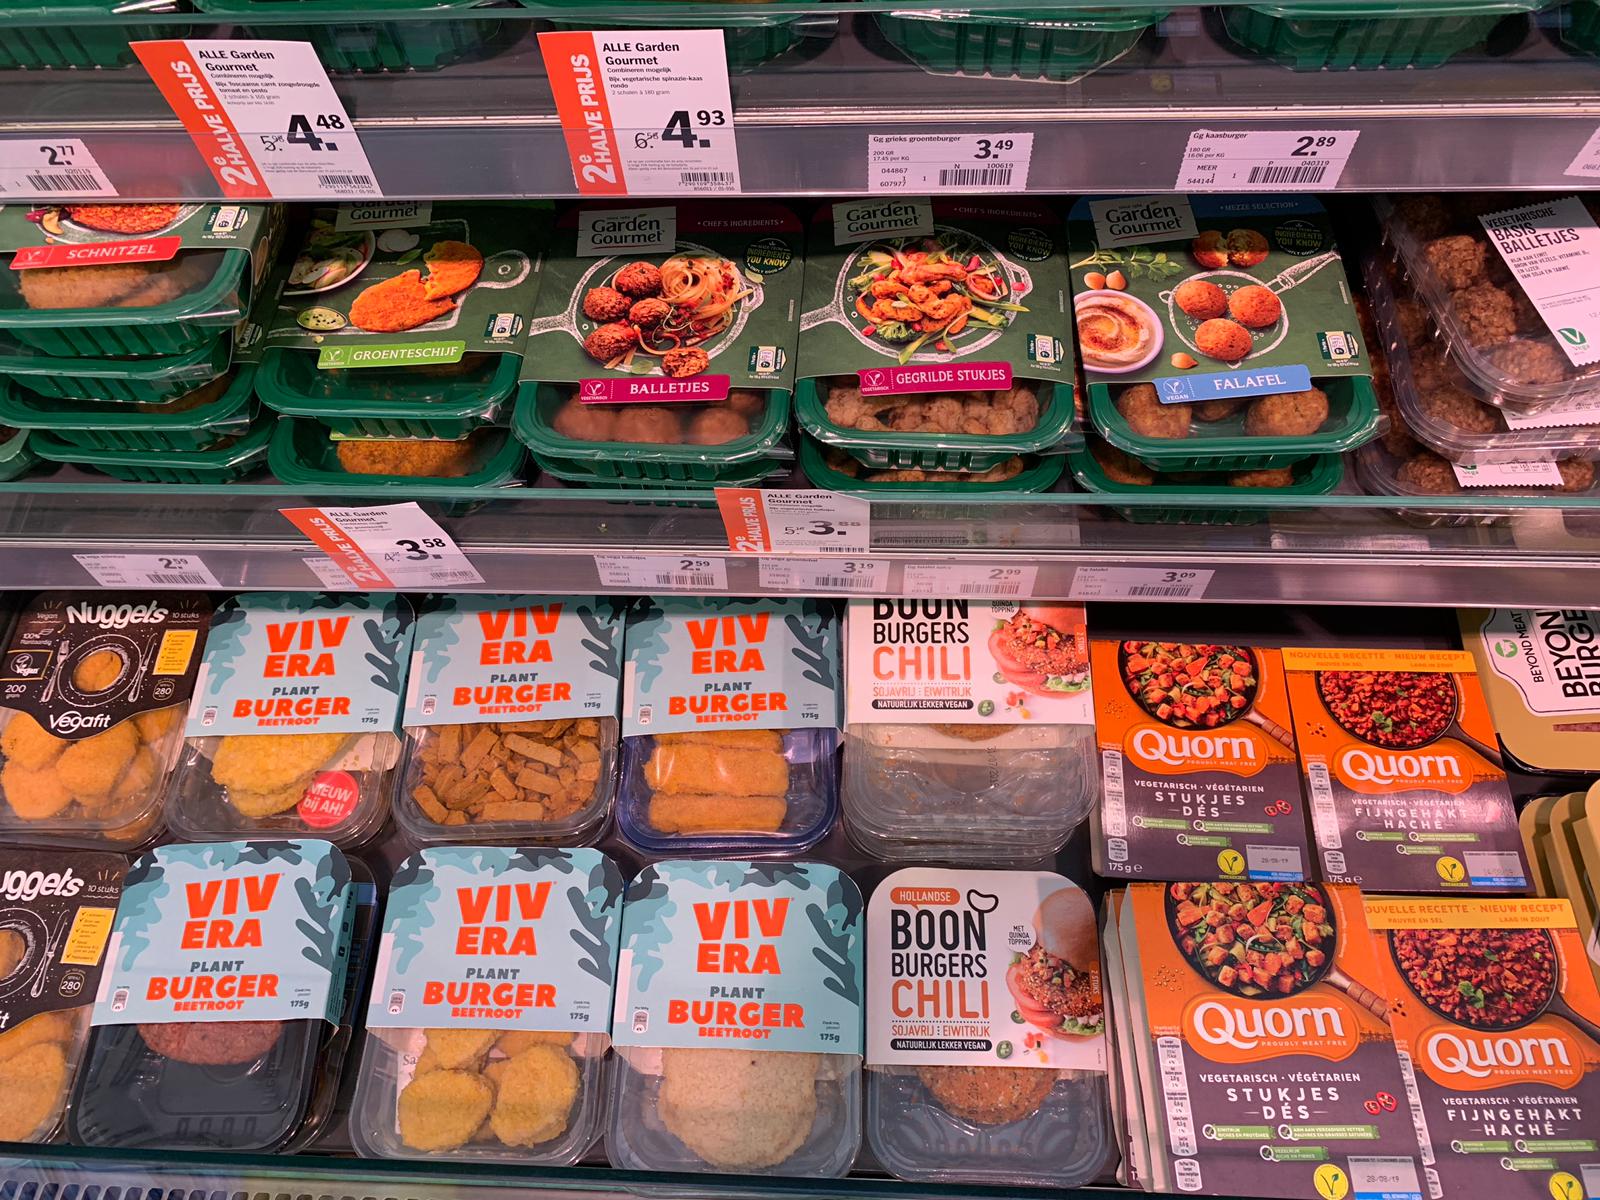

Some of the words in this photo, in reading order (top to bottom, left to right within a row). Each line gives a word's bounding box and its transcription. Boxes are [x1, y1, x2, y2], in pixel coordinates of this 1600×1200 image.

[199, 51, 228, 59] ALLE
[231, 51, 274, 60] Garden
[603, 43, 631, 52] ALLE
[635, 43, 679, 51] Garden
[206, 63, 258, 72] Gourmet
[606, 56, 658, 66] Gourmet
[171, 61, 214, 110] PRIJS
[571, 54, 598, 106] PRIJS
[287, 115, 345, 151] 4.48
[584, 111, 612, 163] HALVE
[661, 110, 725, 148] 4.93
[202, 114, 246, 166] HALVE
[974, 139, 1013, 159] 3.49
[1291, 136, 1336, 156] 2.89
[40, 146, 75, 165] 2.77
[351, 207, 418, 220] Gourmet
[846, 204, 916, 222] Garden
[1105, 203, 1176, 223] Garden
[1225, 202, 1253, 211] MEZZE
[1255, 202, 1294, 210] SELECTION
[591, 219, 661, 233] Garden
[847, 215, 921, 233] Gourmet
[1109, 218, 1182, 236] Gourmet
[1486, 207, 1556, 229] VEGETARISCHE
[591, 232, 664, 245] Gourmet
[1492, 223, 1536, 241] BASIS
[1501, 228, 1580, 254] BALLETJES
[66, 244, 156, 260] SCHNITZEL
[764, 258, 788, 267] KNOW
[354, 347, 458, 361] GROENTESCHIJF
[897, 371, 953, 385] GEGRILDE
[958, 370, 1006, 381] STUKJES
[1213, 374, 1286, 390] FALAFEL
[630, 382, 710, 394] BALLETJES
[740, 497, 756, 517] PRIJS
[310, 517, 344, 542] PRIJS
[745, 519, 763, 541] HALVE
[337, 544, 371, 572] HALVE
[396, 538, 446, 561] 3.58
[158, 558, 188, 569] 2.59
[843, 562, 874, 573] 3.19
[989, 569, 1021, 579] 2.99
[1162, 572, 1196, 582] 3.09
[66, 600, 168, 629] Nuggets
[478, 603, 564, 641] VIV
[266, 616, 350, 652] VIV
[685, 612, 770, 649] VIV
[874, 622, 969, 644] BURGERS
[1511, 612, 1529, 639] MEAT
[480, 640, 553, 665] ERA
[692, 649, 765, 674] ERA
[1522, 638, 1544, 683] BEYOND
[263, 653, 335, 678] ERA
[873, 646, 970, 680] CHILI
[5, 685, 26, 693] 200
[155, 687, 172, 695] 280
[272, 686, 320, 695] PLANT
[453, 683, 571, 706] BURGER
[233, 697, 350, 717] BURGER
[669, 692, 788, 715] BURGER
[50, 711, 111, 733] Vegafit
[1133, 729, 1255, 766] Quorn
[1342, 750, 1461, 785] Quorn
[310, 782, 353, 800] NIEUW
[1134, 780, 1197, 790] VEGETARISCH
[1206, 784, 1264, 792] VÉGÉTARIEN
[304, 797, 320, 812] bij
[320, 802, 344, 816] AH!
[1155, 792, 1245, 805] STUKJES
[1183, 803, 1220, 817] DÉS
[1355, 808, 1468, 818] FIJNGEHAKT
[1384, 818, 1443, 829] HACHÉ
[186, 873, 280, 919] VIV
[456, 881, 552, 924] VIV
[900, 892, 951, 902] HOLLANDSE
[1419, 904, 1468, 914] RECETTE
[1480, 904, 1512, 914] NIEUW
[1514, 904, 1564, 913] RECEPT
[693, 897, 790, 941] VIV
[181, 919, 262, 949] ERA
[891, 909, 986, 951] BOON
[456, 927, 537, 956] ERA
[1008, 938, 1031, 946] TOPPING
[190, 961, 244, 972] PLANT
[697, 943, 781, 974] ERA
[892, 953, 987, 978] BURGERS
[466, 968, 520, 980] PLANT
[61, 981, 80, 990] 280
[146, 974, 279, 1000] BURGER
[710, 986, 765, 999] PLANT
[423, 982, 556, 1008] BURGER
[892, 979, 989, 1019] CHILI
[174, 1000, 244, 1011] BEETROOT
[451, 1008, 522, 1019] BEETROOT
[668, 1000, 805, 1028] BURGER
[699, 1027, 771, 1039] BEETROOT
[892, 1025, 934, 1036] SOJAVRIJ
[943, 1025, 990, 1037] EIWITRIJK
[1194, 1002, 1344, 1050] Quorn
[820, 1033, 840, 1043] 175g
[897, 1041, 937, 1049] NATUURLIJK
[938, 1041, 962, 1049] LEKKER
[964, 1041, 986, 1049] VEGAN
[1427, 1032, 1570, 1078] Quorn
[1200, 1073, 1278, 1083] VEGETARISCH
[1288, 1072, 1361, 1082] VÉGÉTARIEN
[1227, 1087, 1340, 1102] STUKJES
[1443, 1097, 1510, 1105] VEGETARISCH
[1517, 1096, 1578, 1104] VÉGÉTARIEN
[1263, 1103, 1310, 1120] DÉS
[1448, 1109, 1583, 1121] FIJNGEHAKT
[1485, 1120, 1556, 1136] HACHÉ
